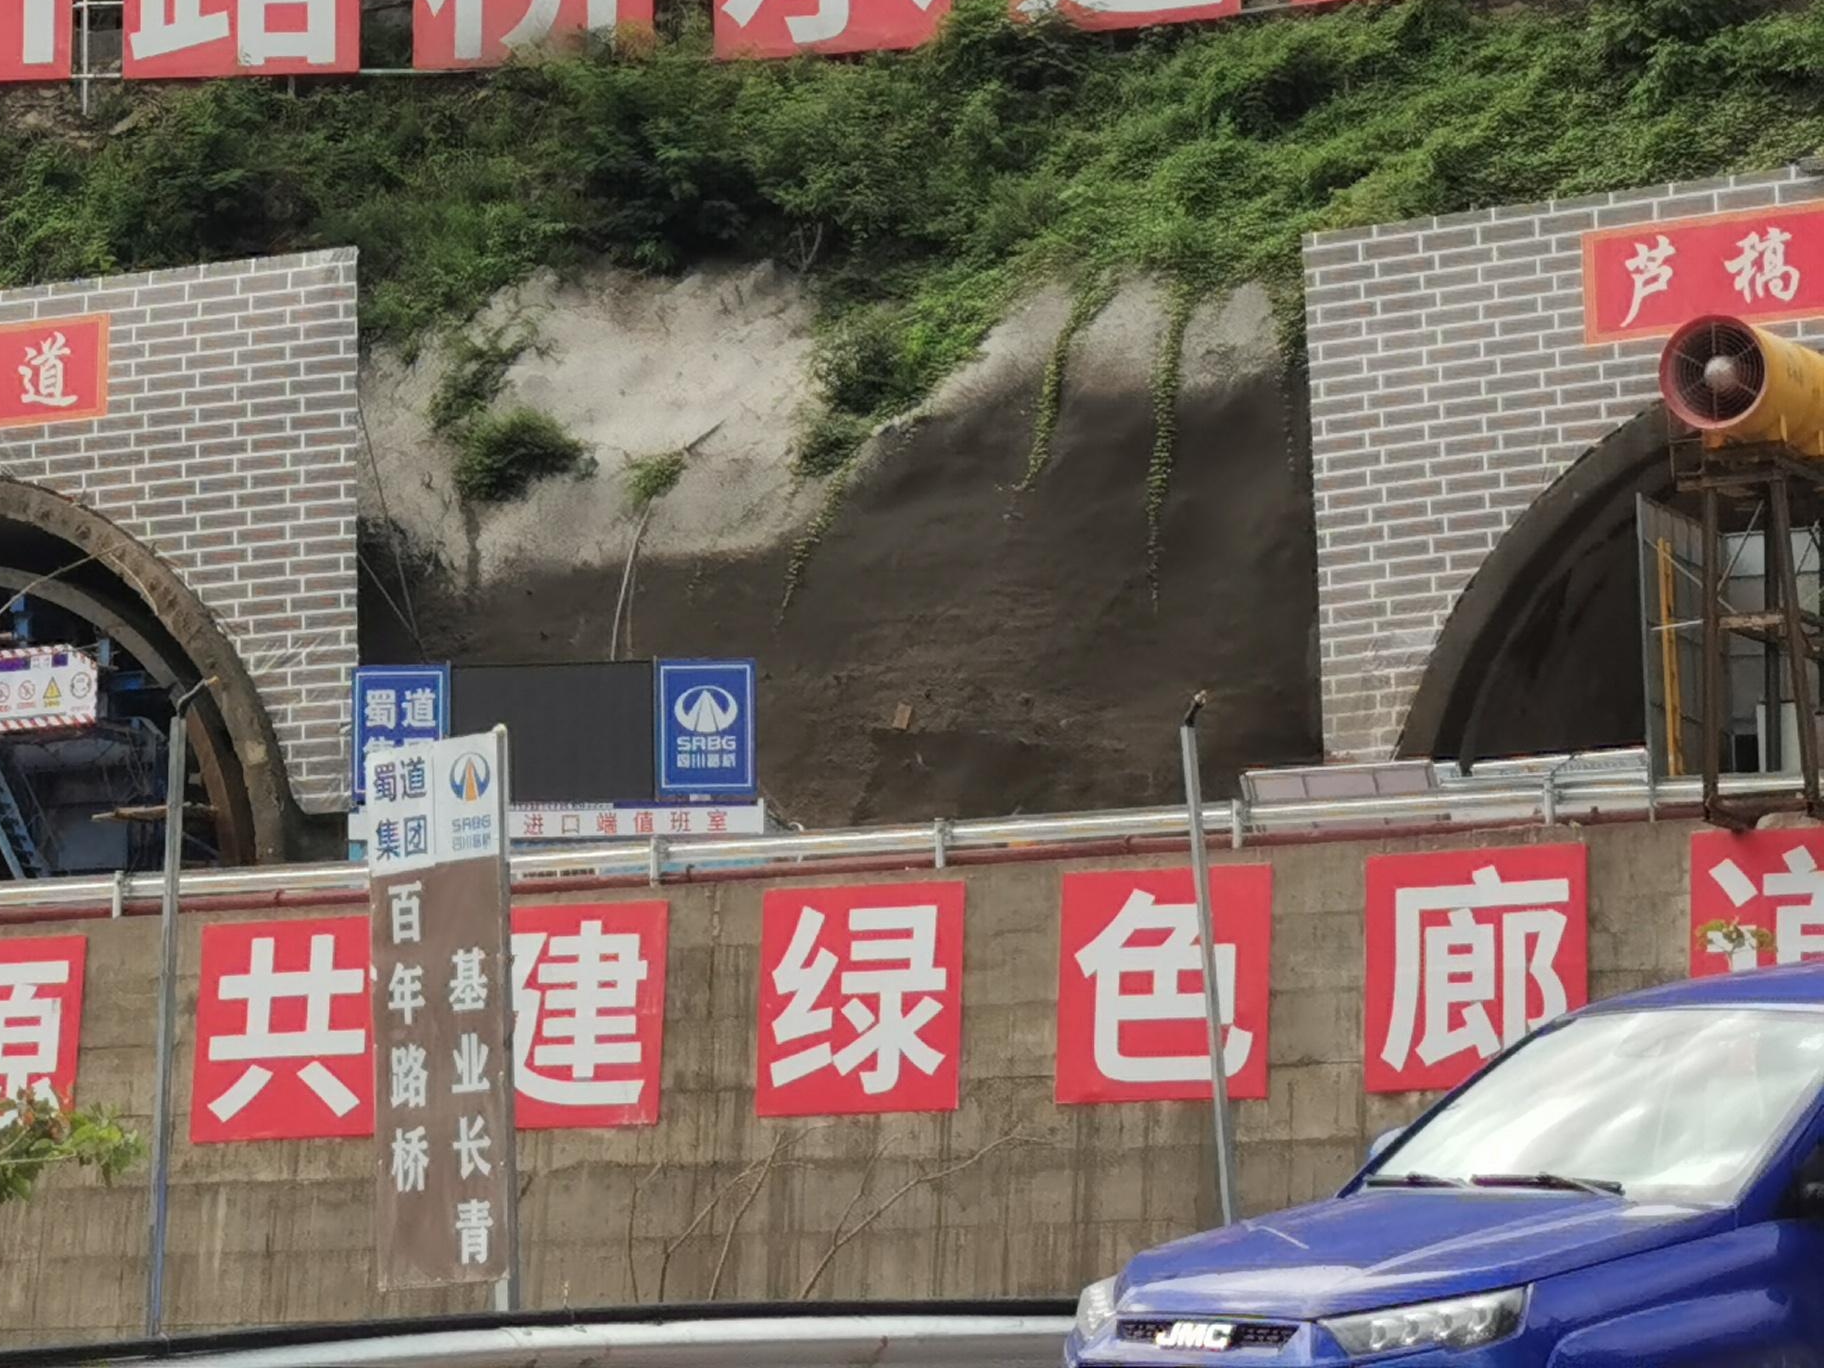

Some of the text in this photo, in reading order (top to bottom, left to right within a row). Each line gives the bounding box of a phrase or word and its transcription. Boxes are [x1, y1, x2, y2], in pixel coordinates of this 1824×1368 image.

[1620, 226, 1801, 328] 芦稿
[363, 687, 436, 730] 蜀道
[676, 735, 736, 751] SRBG
[373, 756, 427, 803] 蜀道
[375, 815, 429, 862] 集团
[523, 809, 728, 836] 进口端值班室
[387, 879, 429, 1194] 百年路桥
[448, 946, 494, 1265] 基业长青
[1155, 1321, 1233, 1352] JMC
